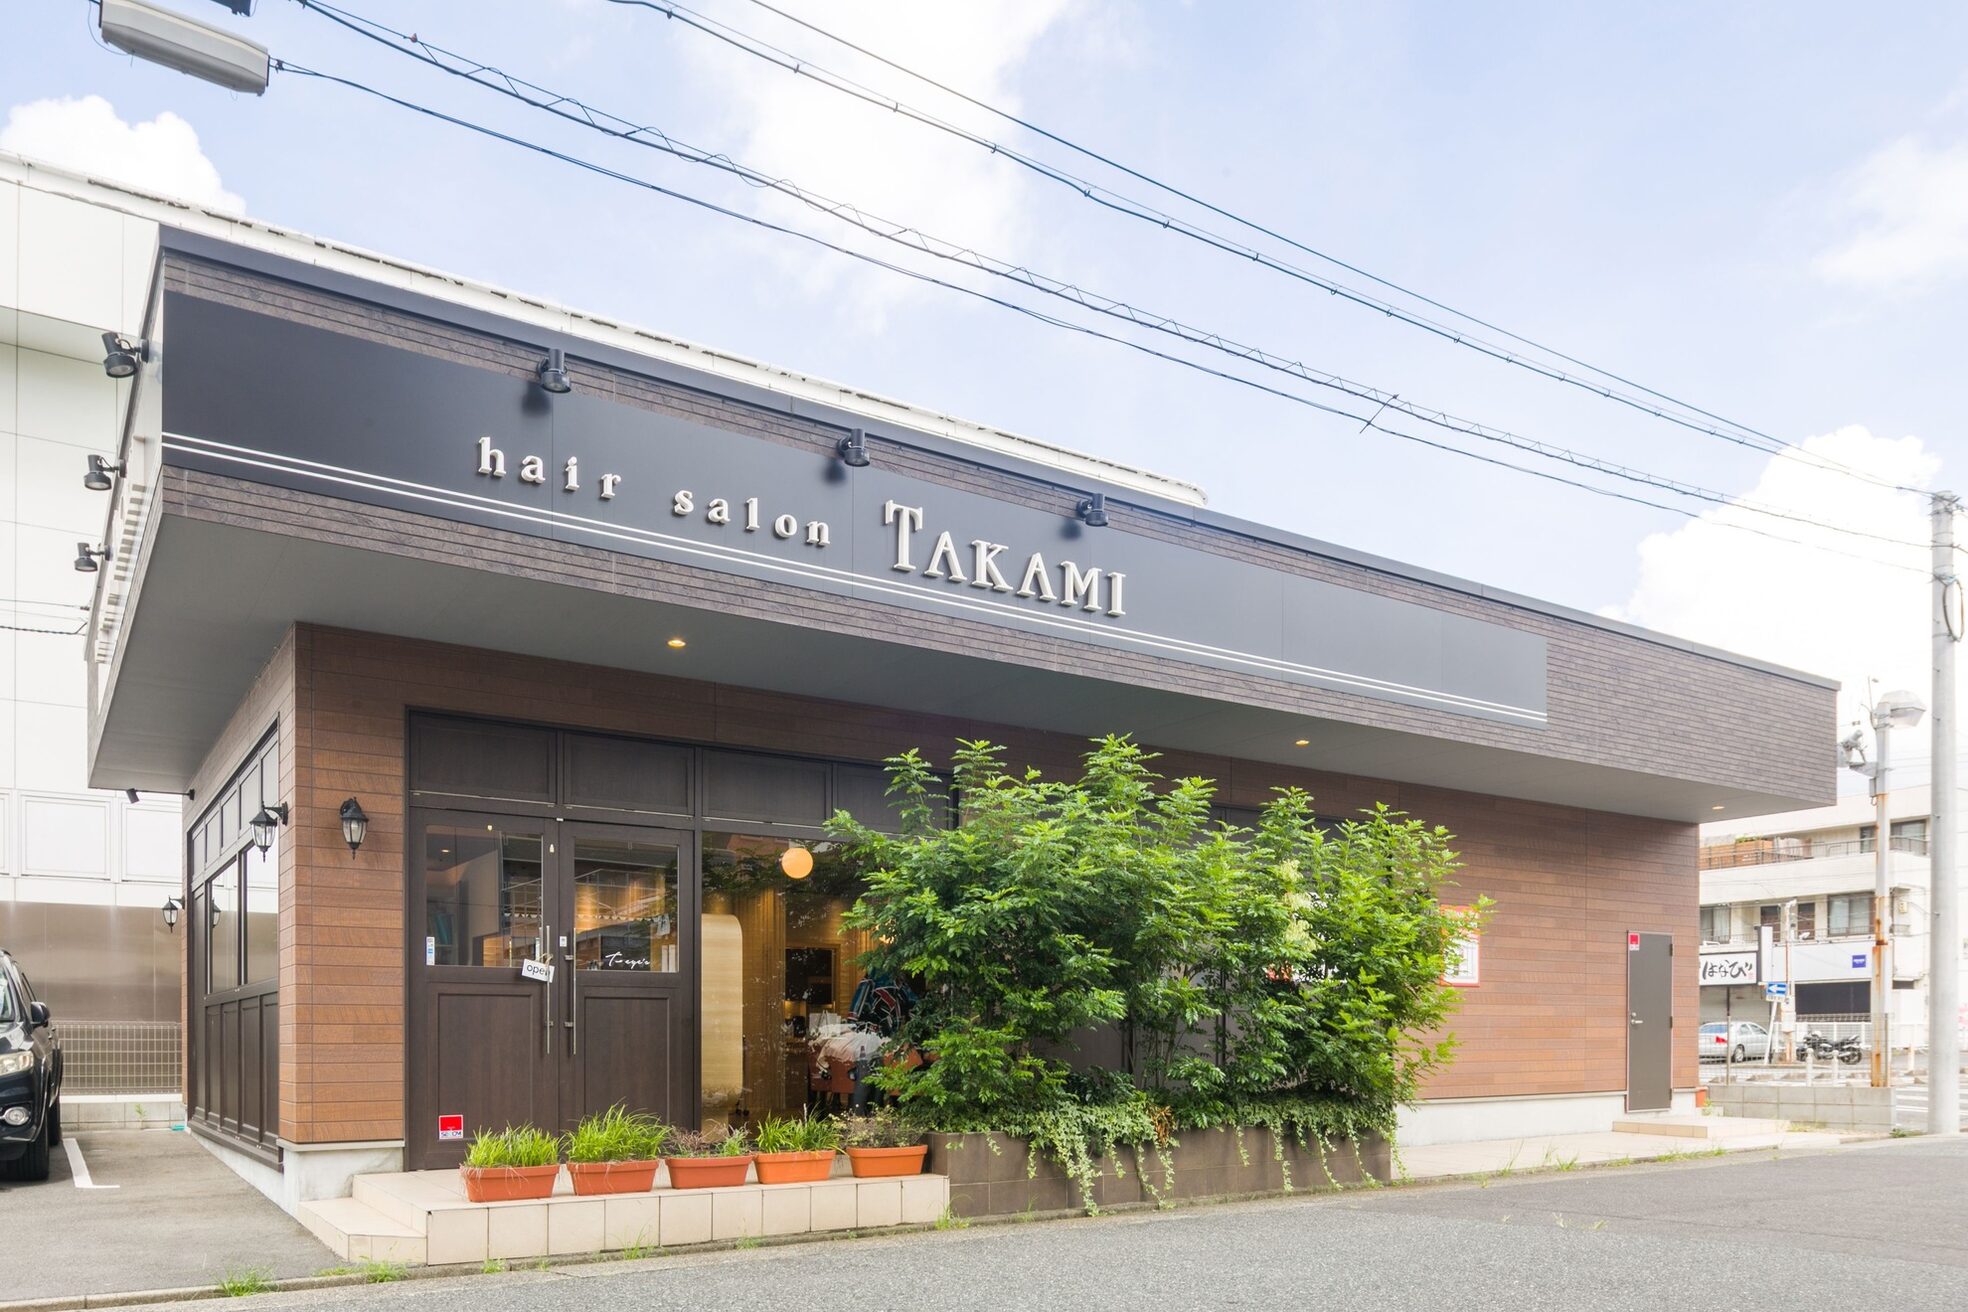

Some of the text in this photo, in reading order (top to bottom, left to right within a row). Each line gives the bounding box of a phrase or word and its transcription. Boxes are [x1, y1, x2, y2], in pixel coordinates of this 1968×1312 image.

[478, 436, 1127, 616] hair salon TAKAMI
[1702, 959, 1753, 980] はなび
